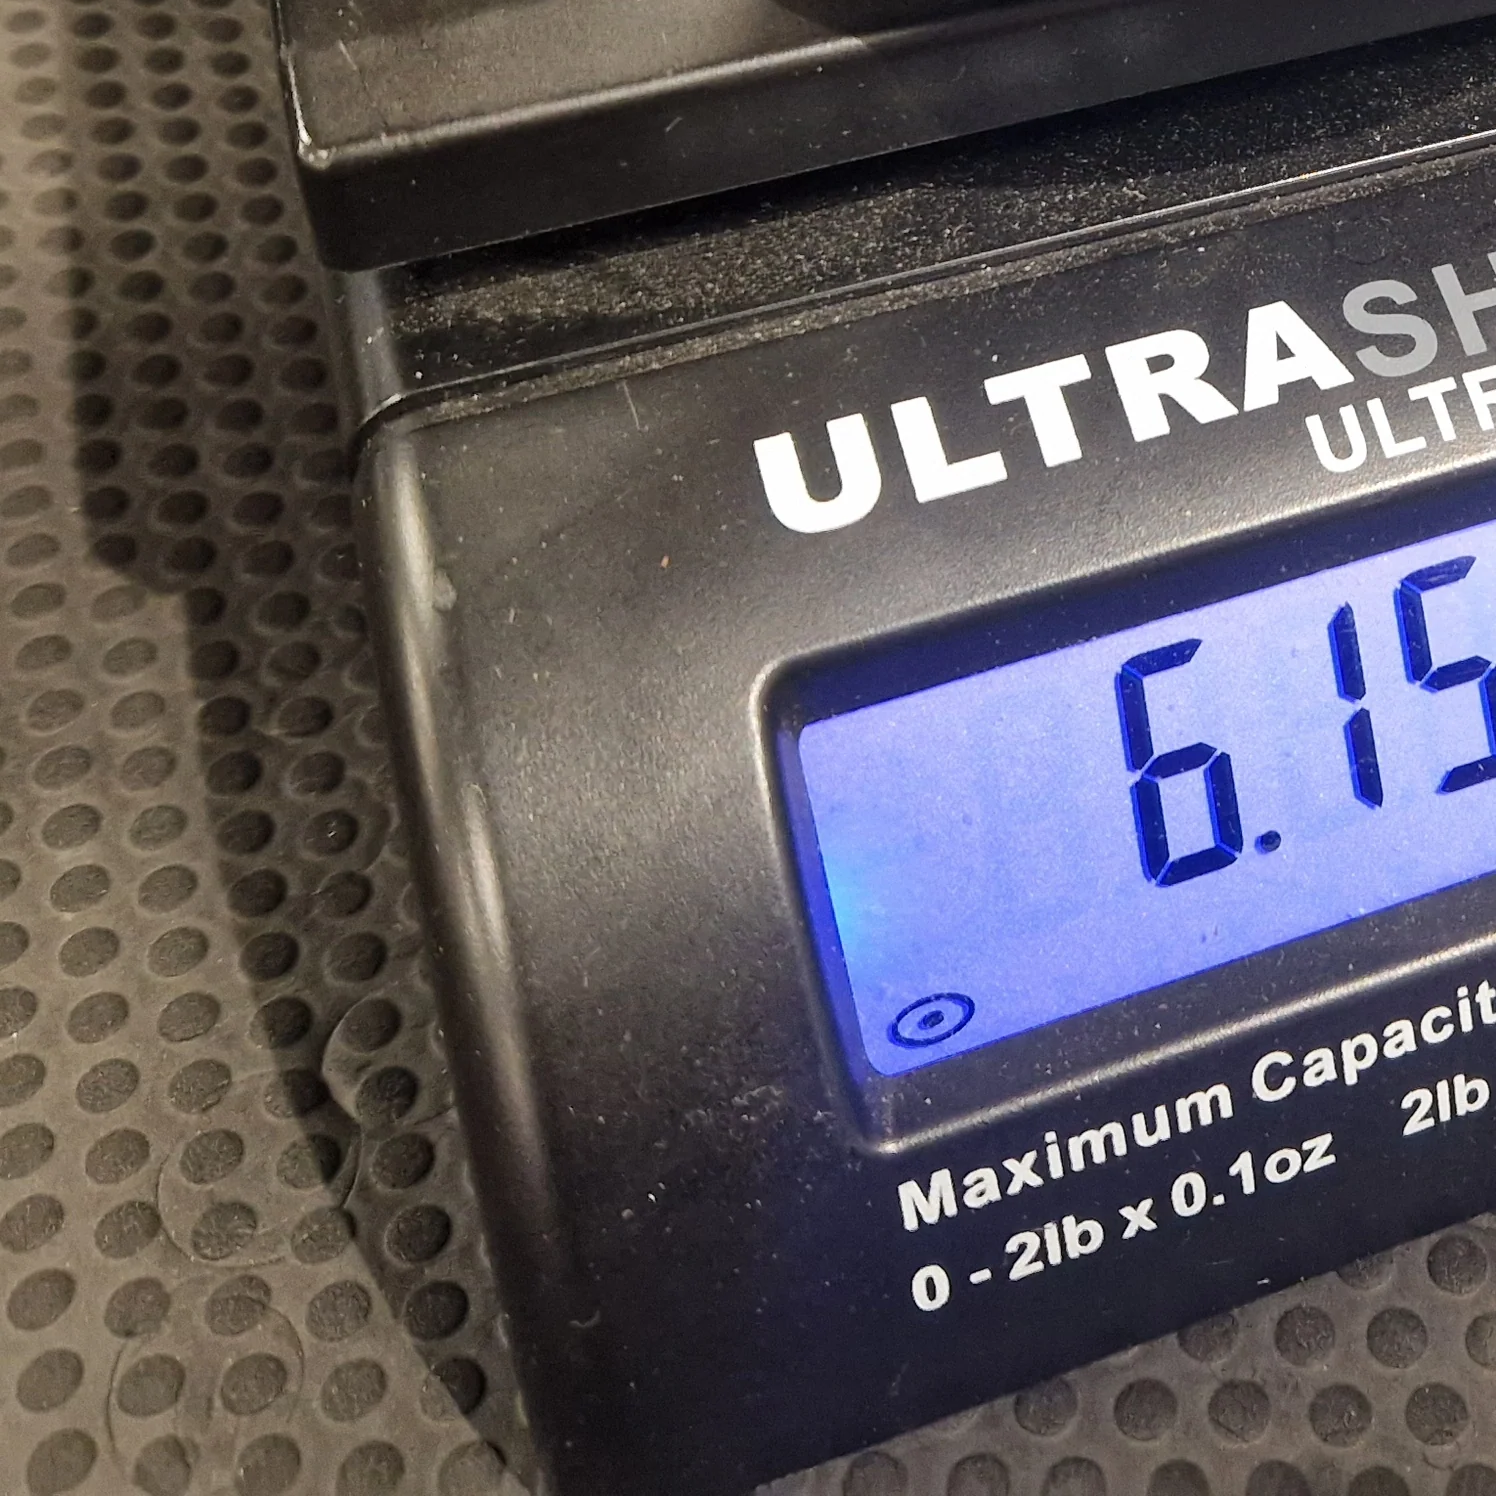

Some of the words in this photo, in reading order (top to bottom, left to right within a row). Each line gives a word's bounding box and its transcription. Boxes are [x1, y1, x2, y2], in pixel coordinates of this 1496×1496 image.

[896, 1083, 1234, 1231] Maximum
[910, 1264, 950, 1312] 0
[1004, 1216, 1105, 1281] 2lb
[1119, 1202, 1158, 1240] x
[1169, 1132, 1337, 1219] 0.1oz
[1399, 1072, 1491, 1137] 2lb
